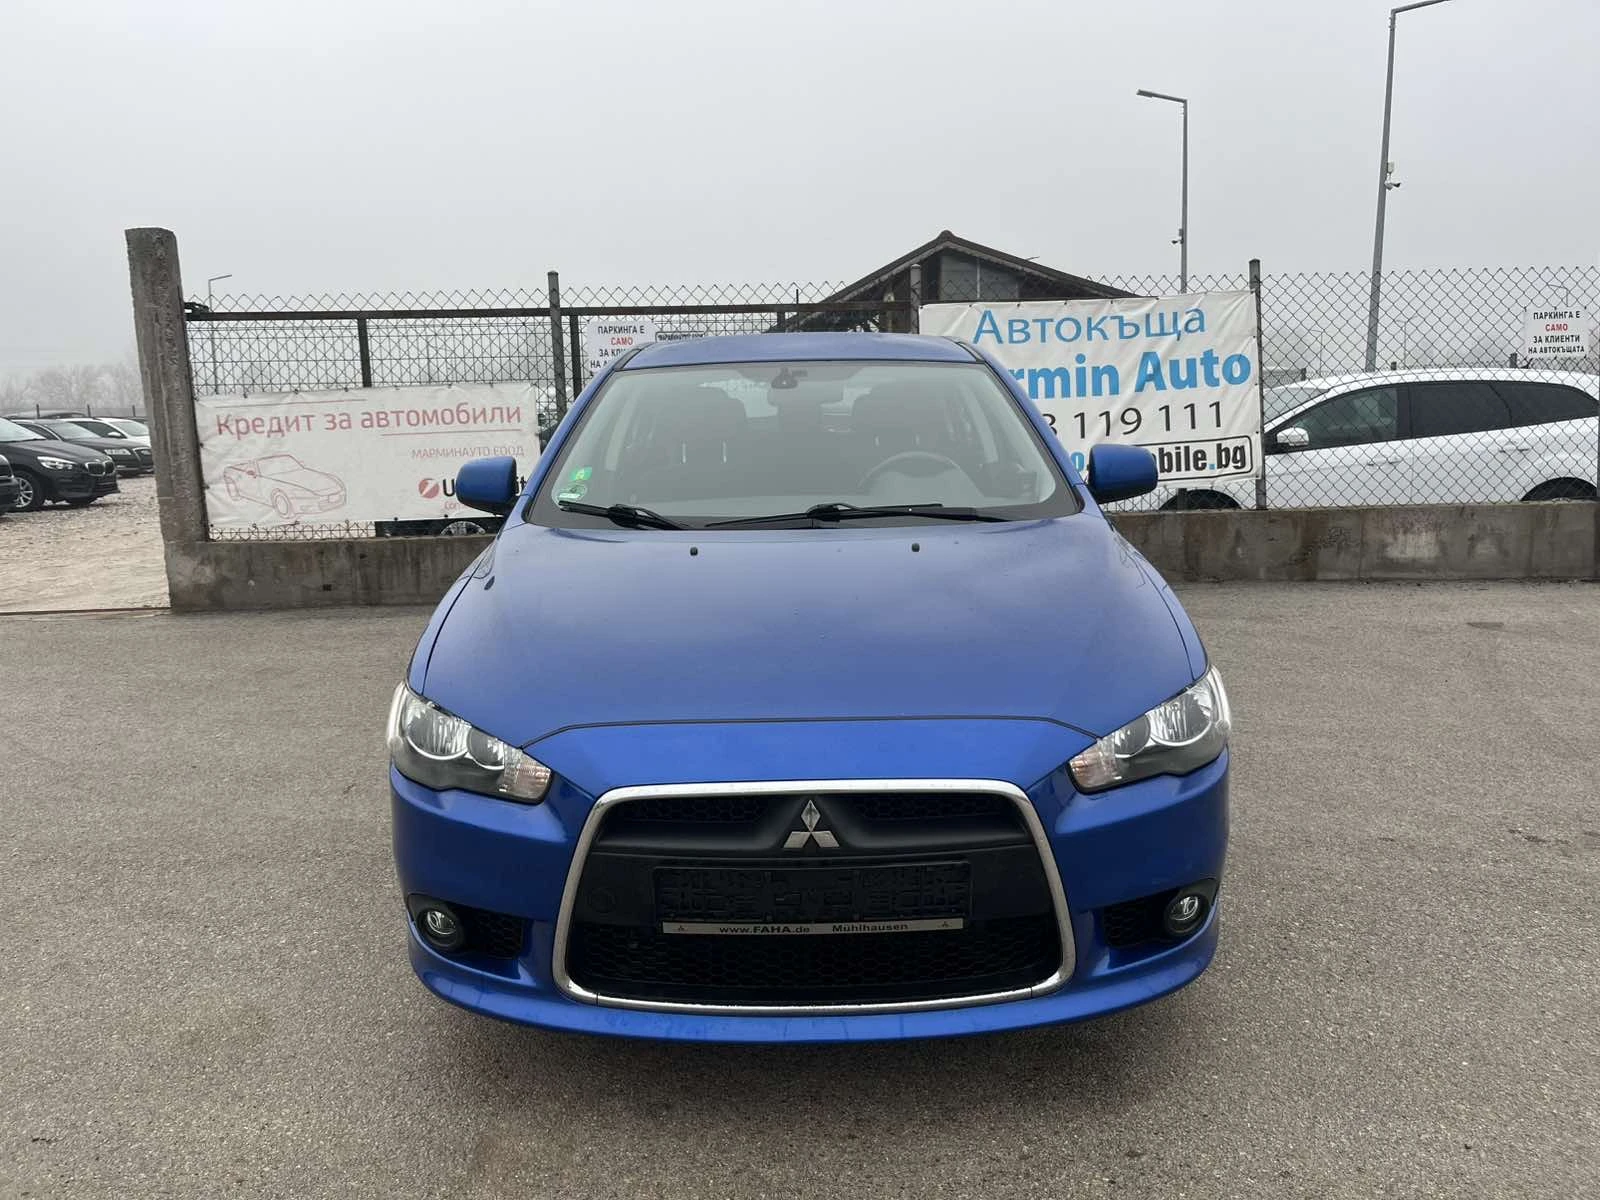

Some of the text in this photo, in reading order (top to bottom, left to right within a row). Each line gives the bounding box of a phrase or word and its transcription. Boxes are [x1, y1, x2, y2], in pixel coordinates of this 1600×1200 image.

[1533, 311, 1573, 320] ПАРКИНГА
[598, 326, 637, 334] ПАРКИНГА
[973, 309, 1206, 344] Автокъща
[1545, 323, 1568, 332] САМО
[611, 337, 634, 346] САМО
[1545, 335, 1580, 343] КЛИЕНТИ
[600, 349, 609, 357] ЗА
[590, 360, 601, 369] НА
[1135, 350, 1251, 393] Auto
[216, 402, 521, 440] Кредит за автомобили
[1074, 407, 1142, 440] 119
[1159, 401, 1222, 432] 111
[1152, 442, 1246, 473] bile.bg
[719, 926, 810, 934] www.FAHA.de
